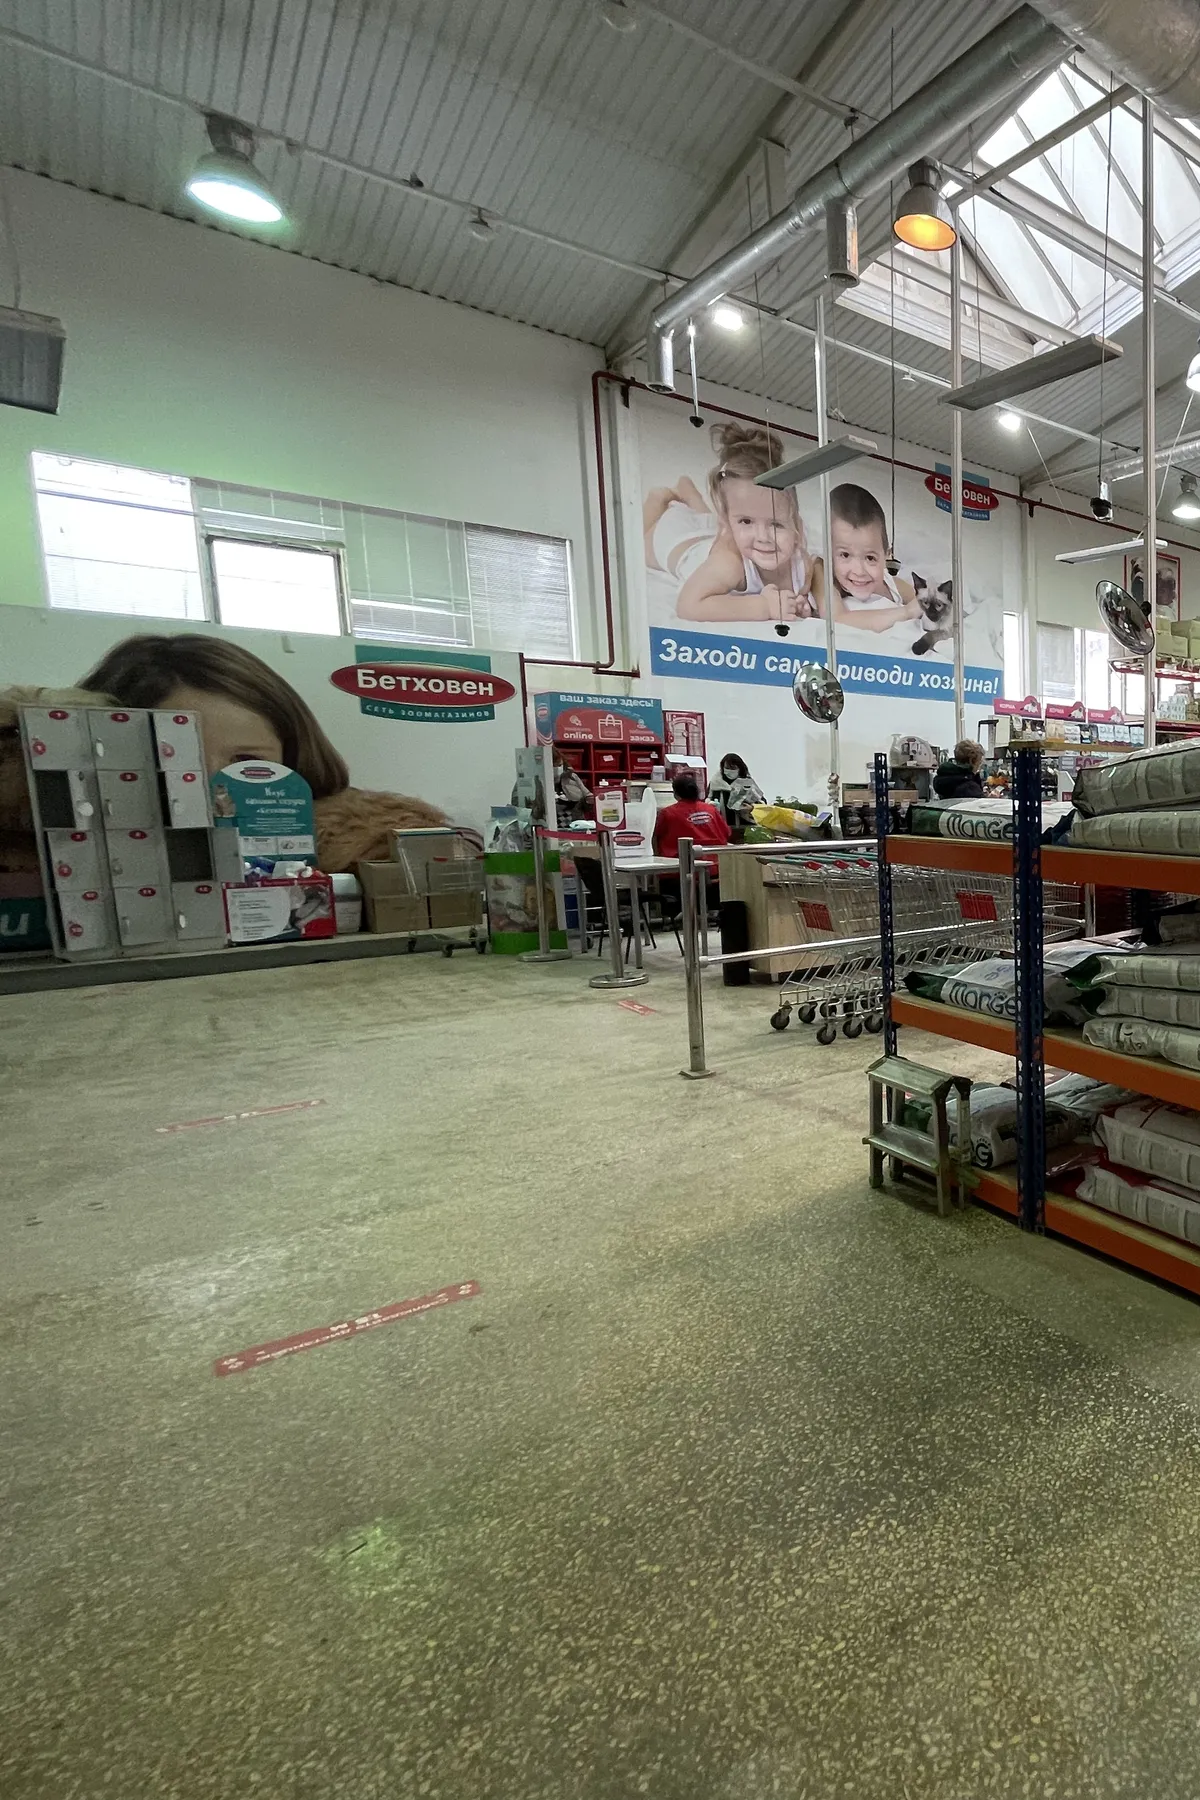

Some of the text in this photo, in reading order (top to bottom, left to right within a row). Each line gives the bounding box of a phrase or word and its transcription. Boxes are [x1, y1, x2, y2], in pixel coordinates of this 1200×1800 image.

[934, 477, 991, 506] Беовен
[658, 637, 757, 670] Заходи
[837, 662, 914, 687] риводи
[356, 668, 494, 697] Бетховен
[559, 694, 654, 708] ваш заказ здесь!
[365, 704, 490, 719] СЕТЬ ЗООМАГАЗИНОВ
[563, 731, 594, 740] online
[629, 735, 655, 743] заказ
